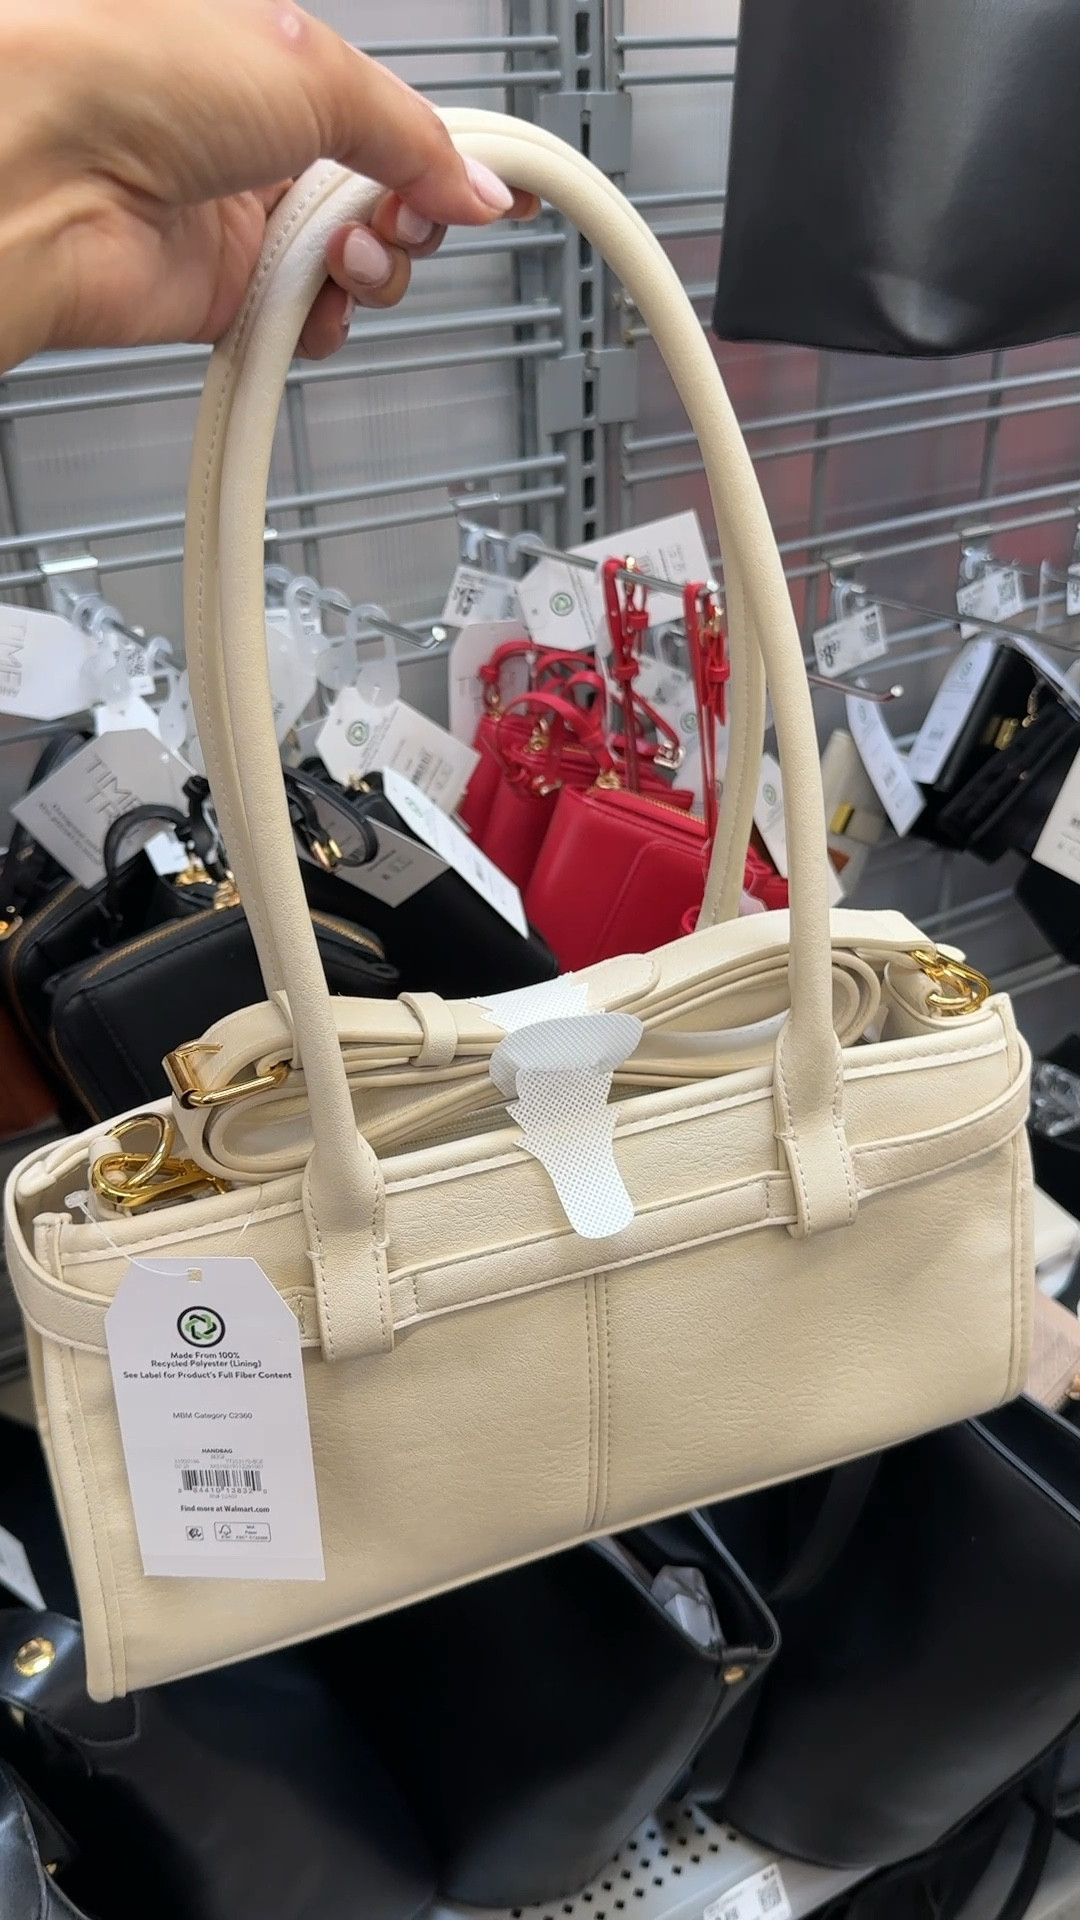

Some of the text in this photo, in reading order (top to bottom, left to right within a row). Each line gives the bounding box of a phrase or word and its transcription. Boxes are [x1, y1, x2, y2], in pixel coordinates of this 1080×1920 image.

[170, 1351, 240, 1359] Made From 100%
[150, 1359, 262, 1369] Recycled Polyester (Lining)
[123, 1371, 292, 1379] See Label for Product's Full Fiber Content
[194, 1412, 227, 1420] Category
